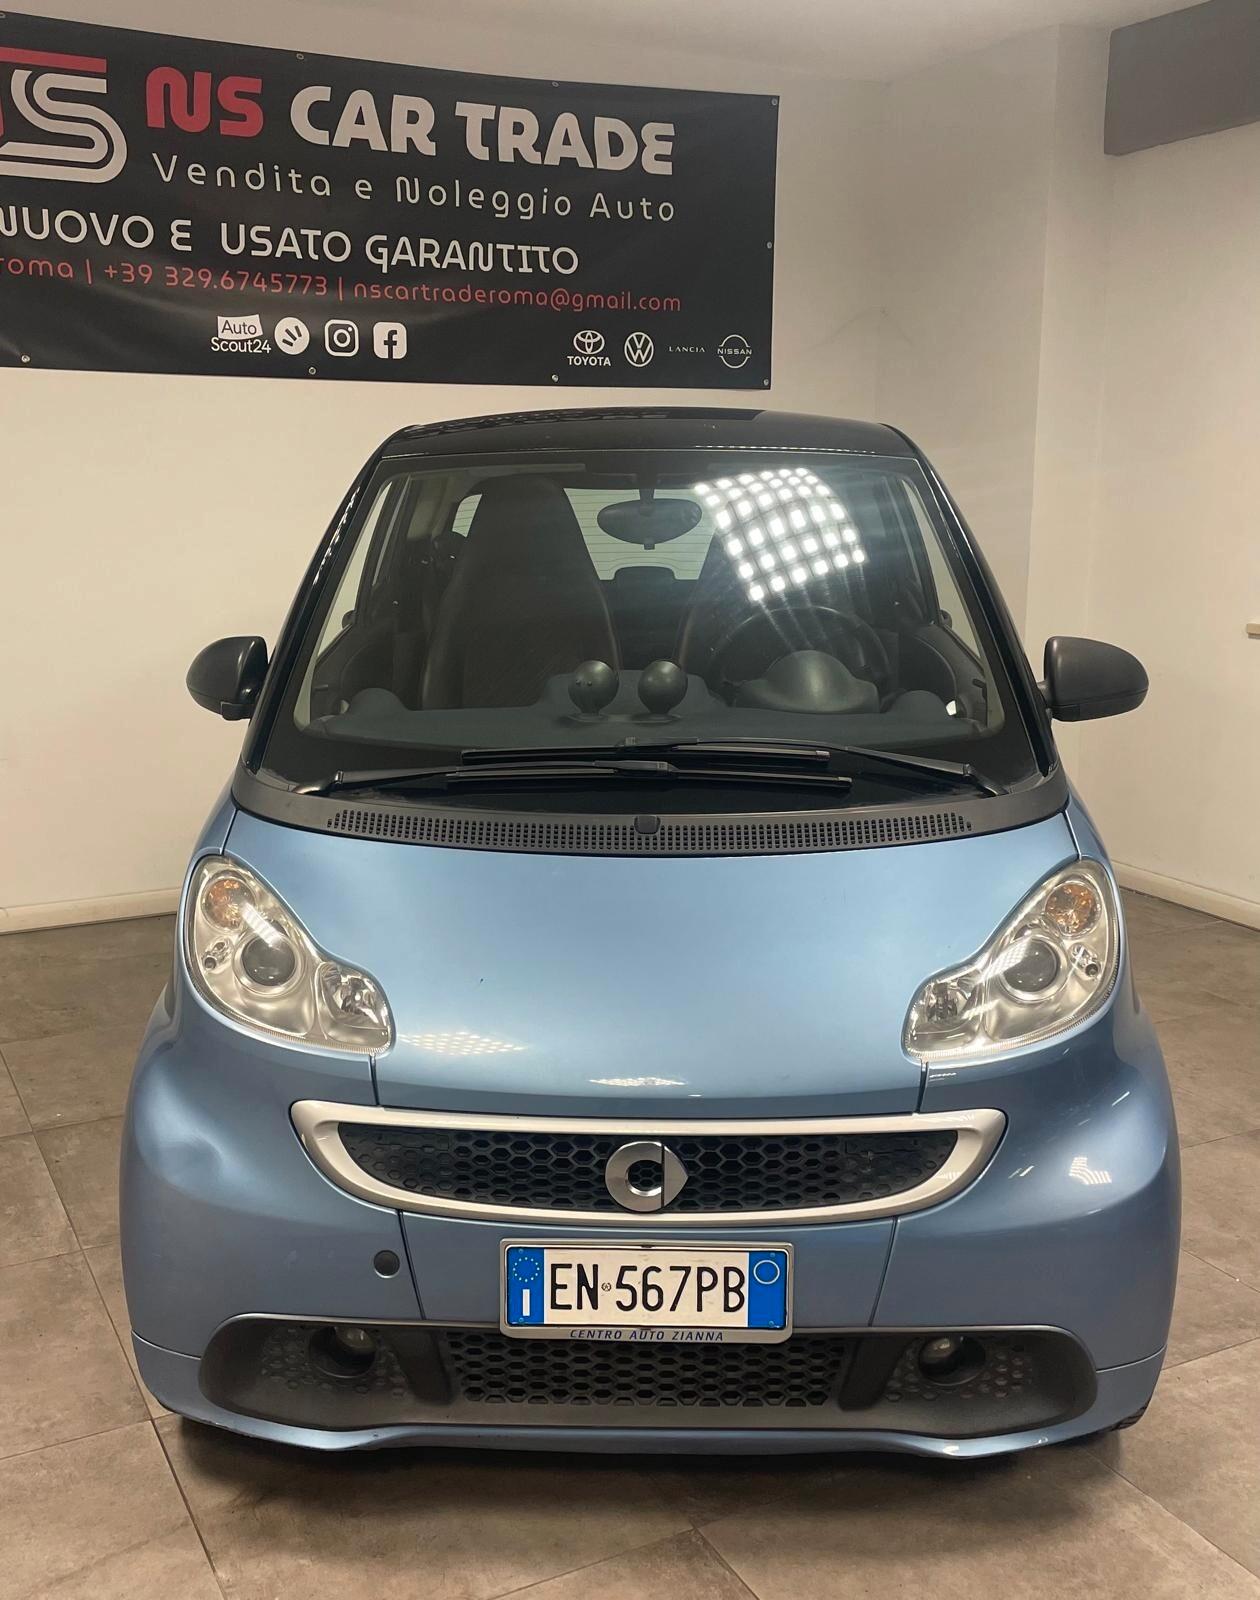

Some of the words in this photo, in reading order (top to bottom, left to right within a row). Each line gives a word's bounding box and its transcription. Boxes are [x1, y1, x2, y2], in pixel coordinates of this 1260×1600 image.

[146, 66, 264, 137] NS
[290, 85, 437, 156] CAR
[455, 101, 675, 176] TRADE
[152, 153, 331, 197] Vendita
[354, 178, 374, 200] e
[396, 176, 571, 220] Noleggio
[589, 193, 675, 222] Auto
[0, 205, 155, 249] NUOVO
[170, 219, 193, 252] E
[220, 222, 351, 263] USATO
[365, 235, 579, 275] GARANTITO
[104, 263, 153, 284] +39
[165, 266, 328, 296] 329.6745773
[354, 281, 681, 312] nscartraderoma@gmail.com
[211, 336, 272, 354] Scout24
[221, 320, 258, 336] Auto
[567, 355, 612, 367] TOYOTA
[550, 1263, 599, 1310] EN
[615, 1265, 746, 1313] 567PB
[569, 1329, 622, 1340] CENTRO
[629, 1330, 664, 1341] AUTO
[671, 1331, 724, 1342] ZIANNA
